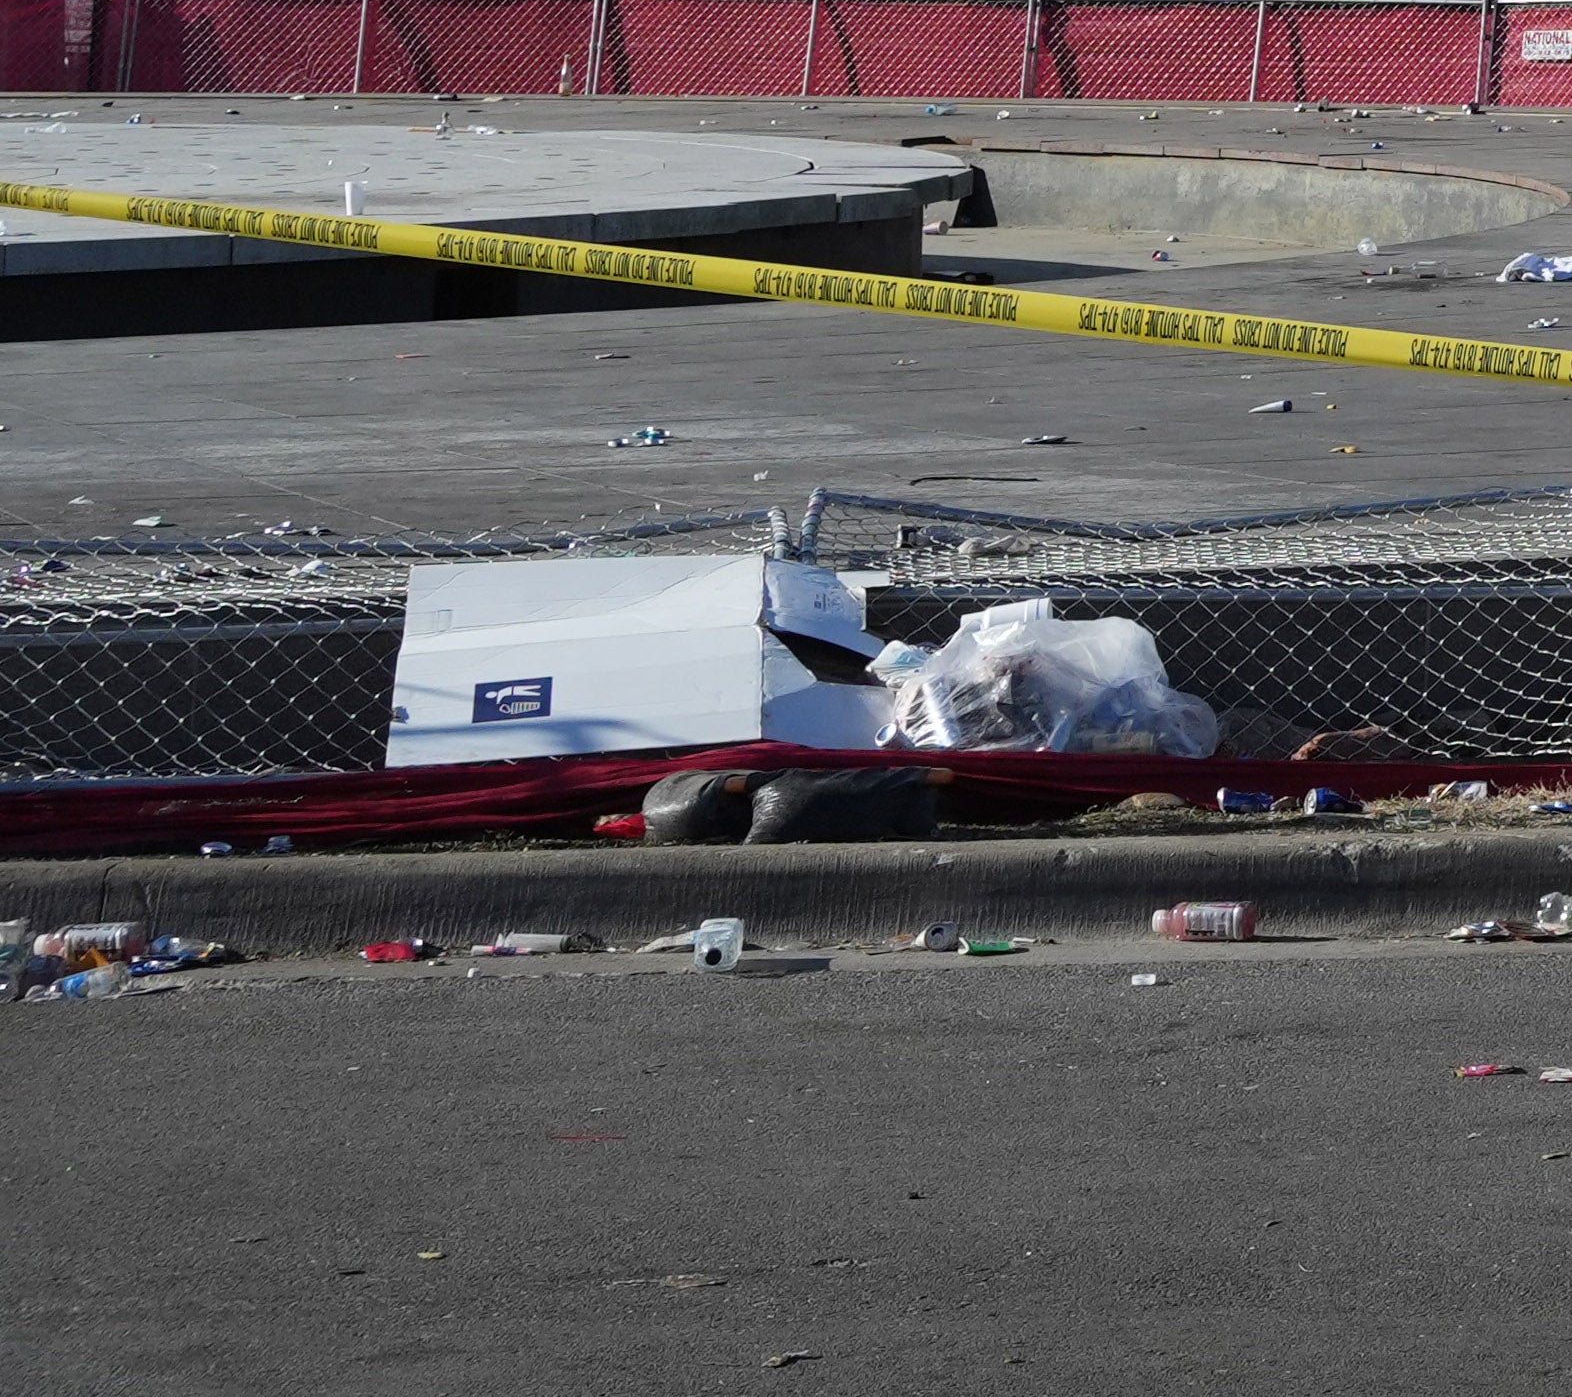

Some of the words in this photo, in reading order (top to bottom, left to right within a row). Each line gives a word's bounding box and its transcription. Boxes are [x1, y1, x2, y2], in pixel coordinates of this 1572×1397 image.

[1525, 32, 1570, 44] NATIONAL
[1079, 303, 1118, 333] 474-TIPS
[1121, 307, 1145, 336] (816)
[1145, 310, 1182, 340] HOTLINE
[1182, 313, 1201, 342] TIPS
[1204, 316, 1224, 344] CALL
[1233, 319, 1262, 348] CROSS
[1263, 322, 1282, 350] NOT
[1282, 324, 1297, 352] DO
[1297, 326, 1317, 354] LINE
[1318, 328, 1349, 357] POLICE
